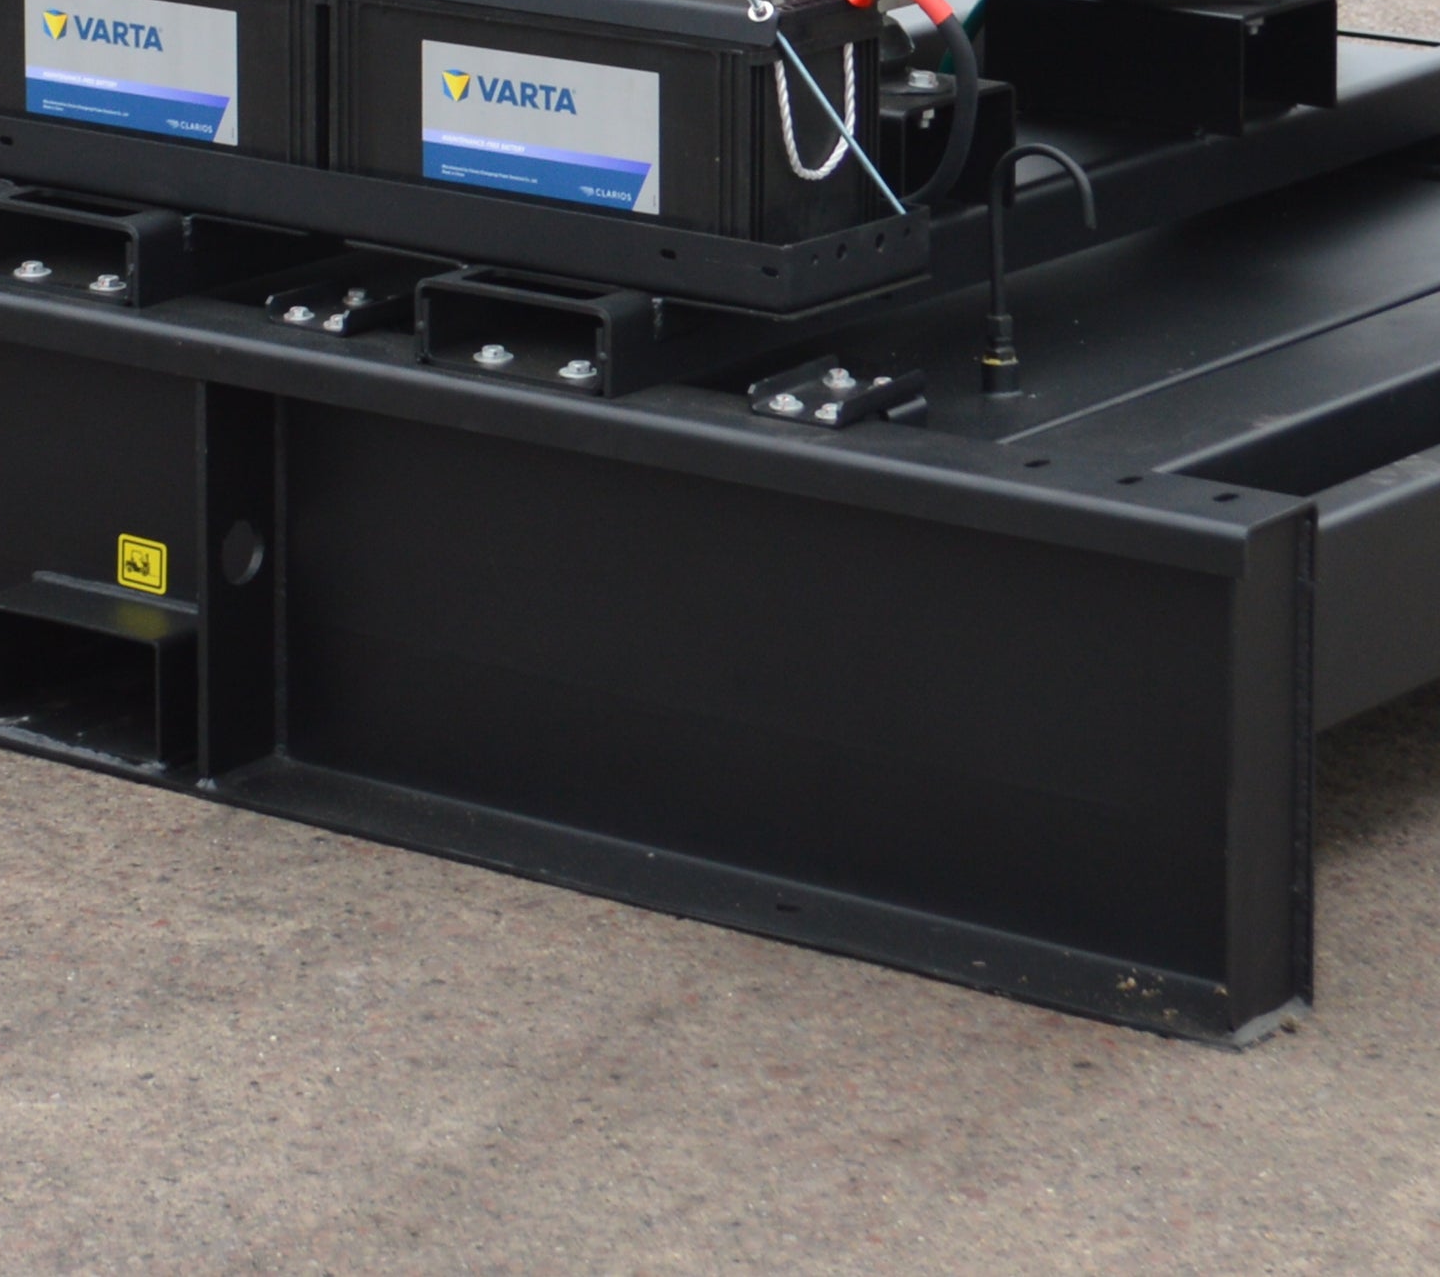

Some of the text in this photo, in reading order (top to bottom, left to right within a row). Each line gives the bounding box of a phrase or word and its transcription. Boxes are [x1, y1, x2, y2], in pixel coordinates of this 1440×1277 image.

[73, 15, 164, 52] VARTA
[477, 75, 577, 115] VARTA
[180, 120, 214, 134] CLARIOS
[595, 187, 633, 202] CLARIOS
